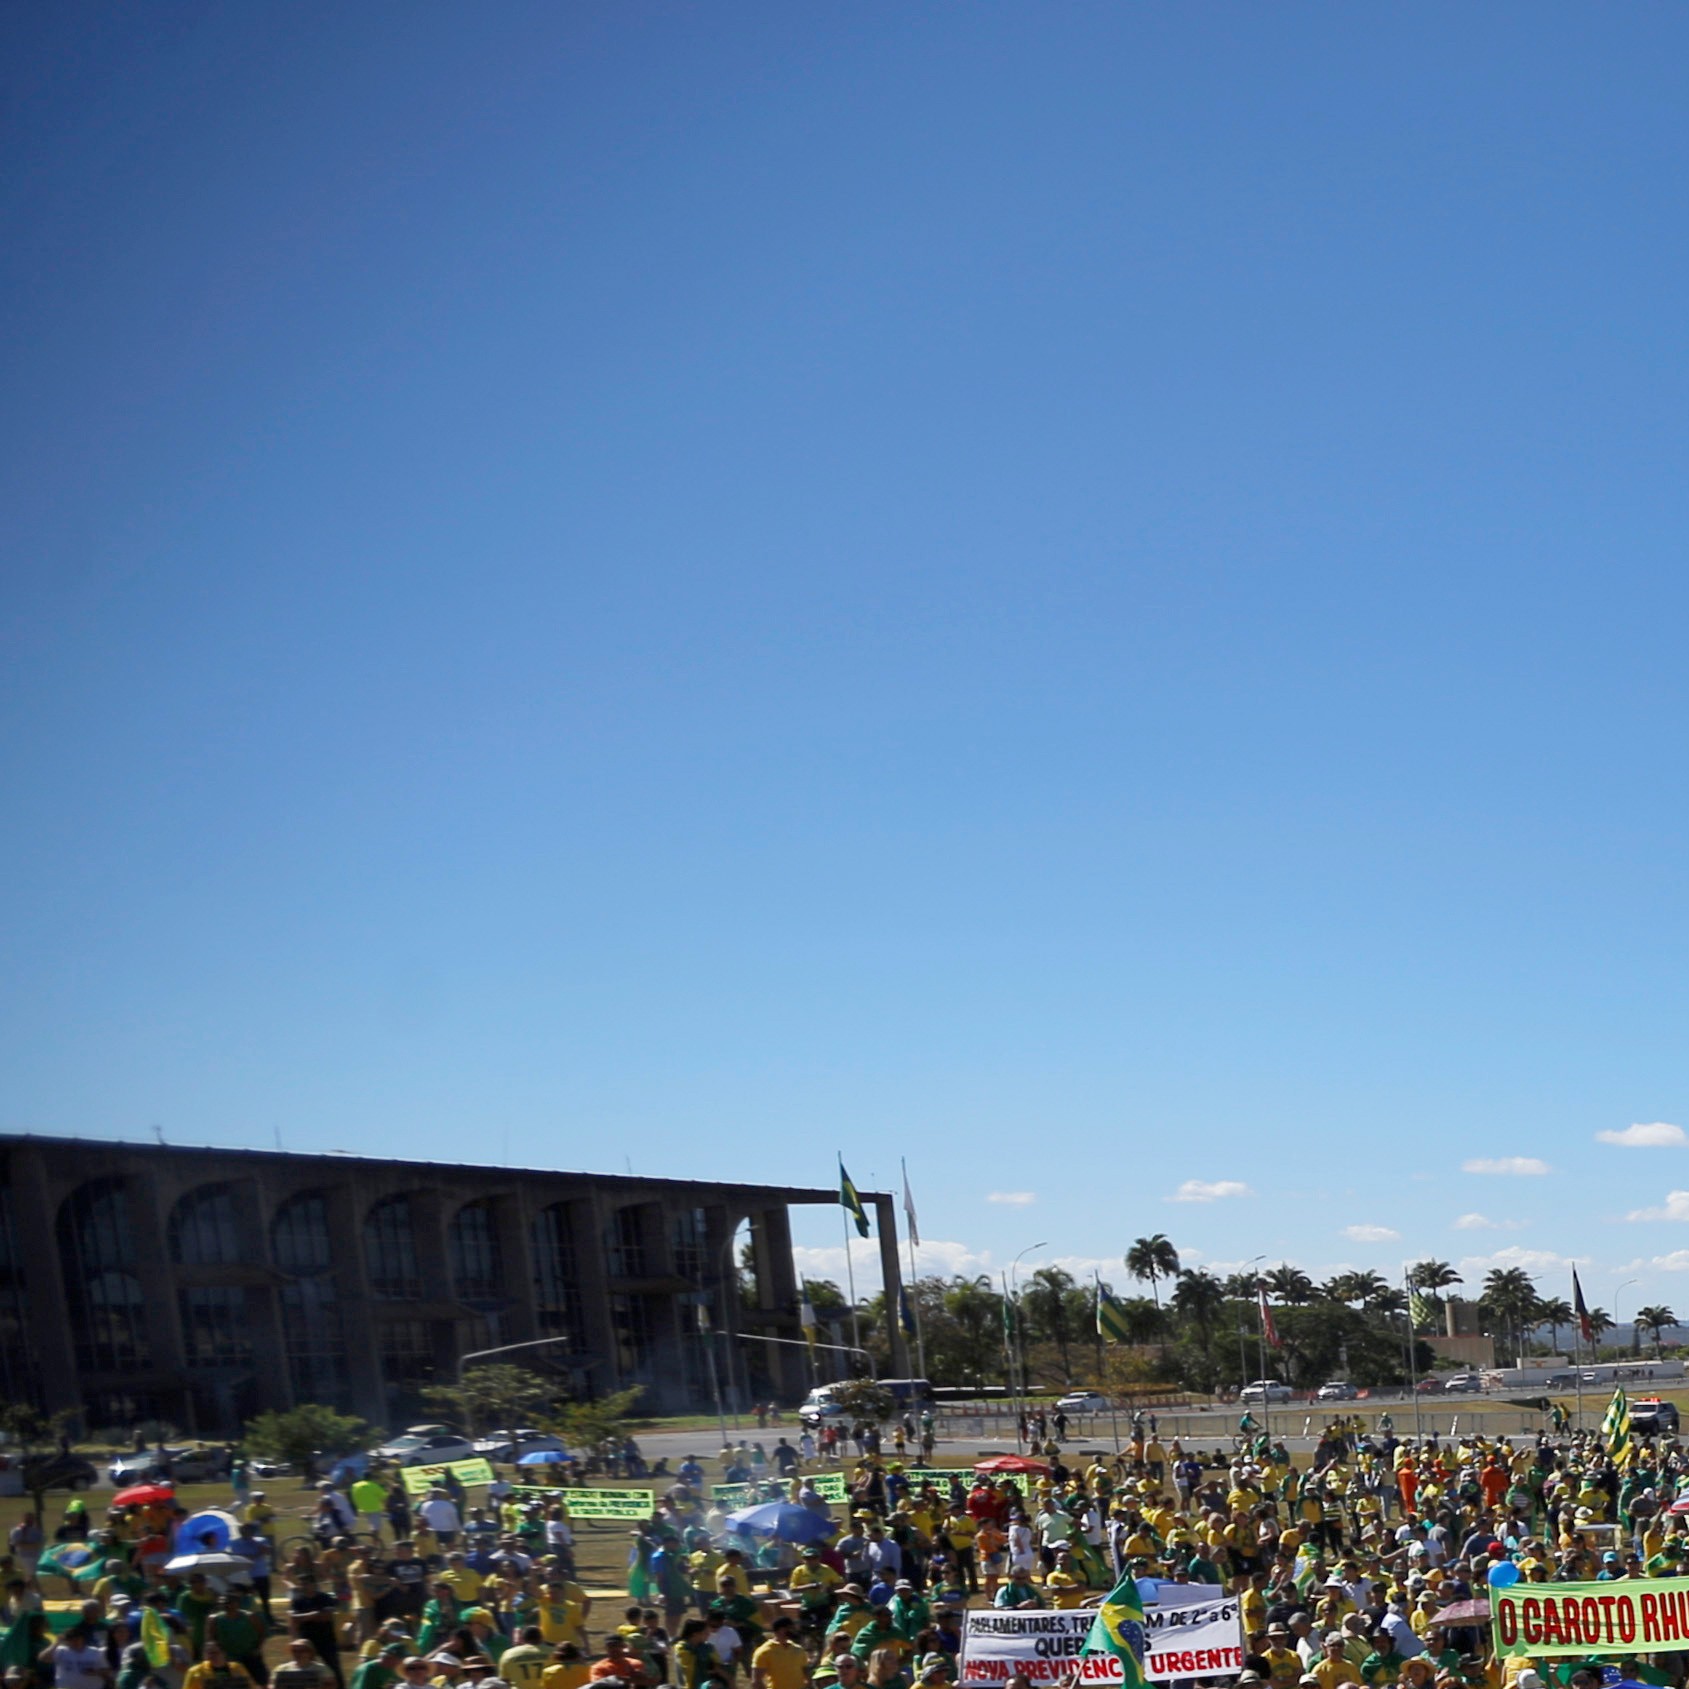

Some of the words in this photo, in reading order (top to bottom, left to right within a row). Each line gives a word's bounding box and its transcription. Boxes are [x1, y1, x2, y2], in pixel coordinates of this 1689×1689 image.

[1170, 1611, 1186, 1626] DE
[1498, 1597, 1518, 1646] O
[1522, 1594, 1636, 1645] GAROTO
[964, 1657, 1010, 1681] NOVA
[1150, 1647, 1243, 1674] URGENTE
